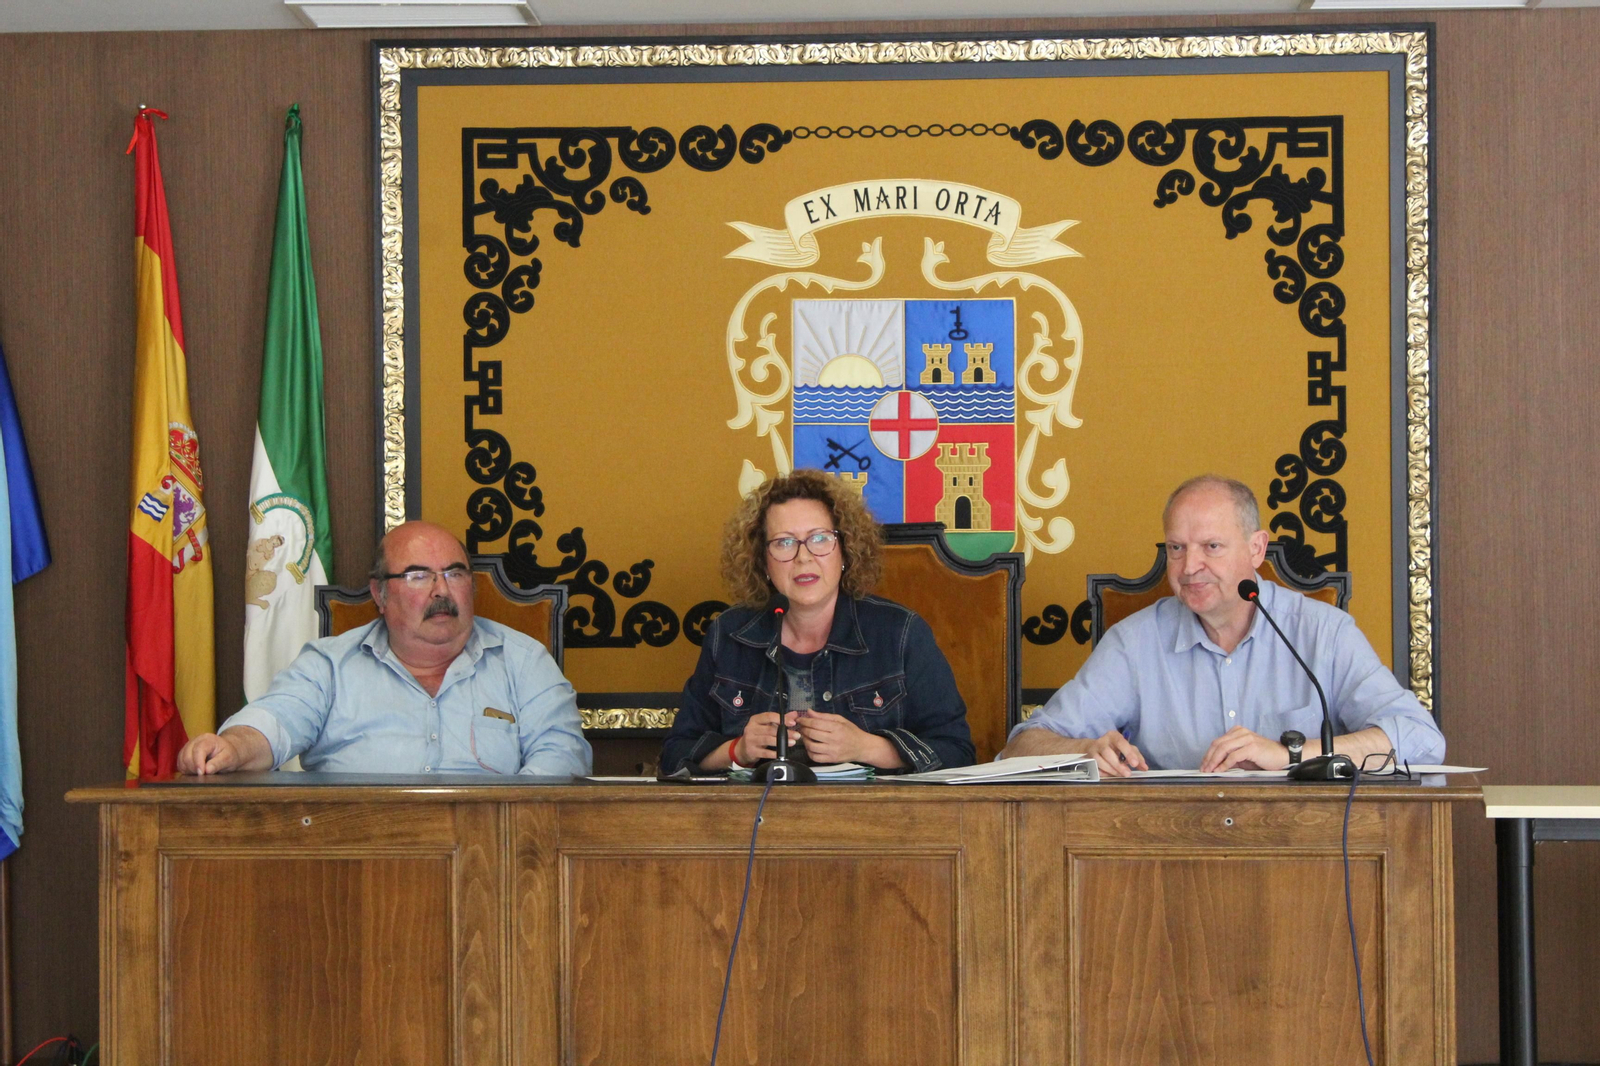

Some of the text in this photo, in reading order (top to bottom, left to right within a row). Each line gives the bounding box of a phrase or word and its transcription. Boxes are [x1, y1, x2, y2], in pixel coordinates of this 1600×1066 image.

[803, 185, 1001, 226] EX MARI ORTA
